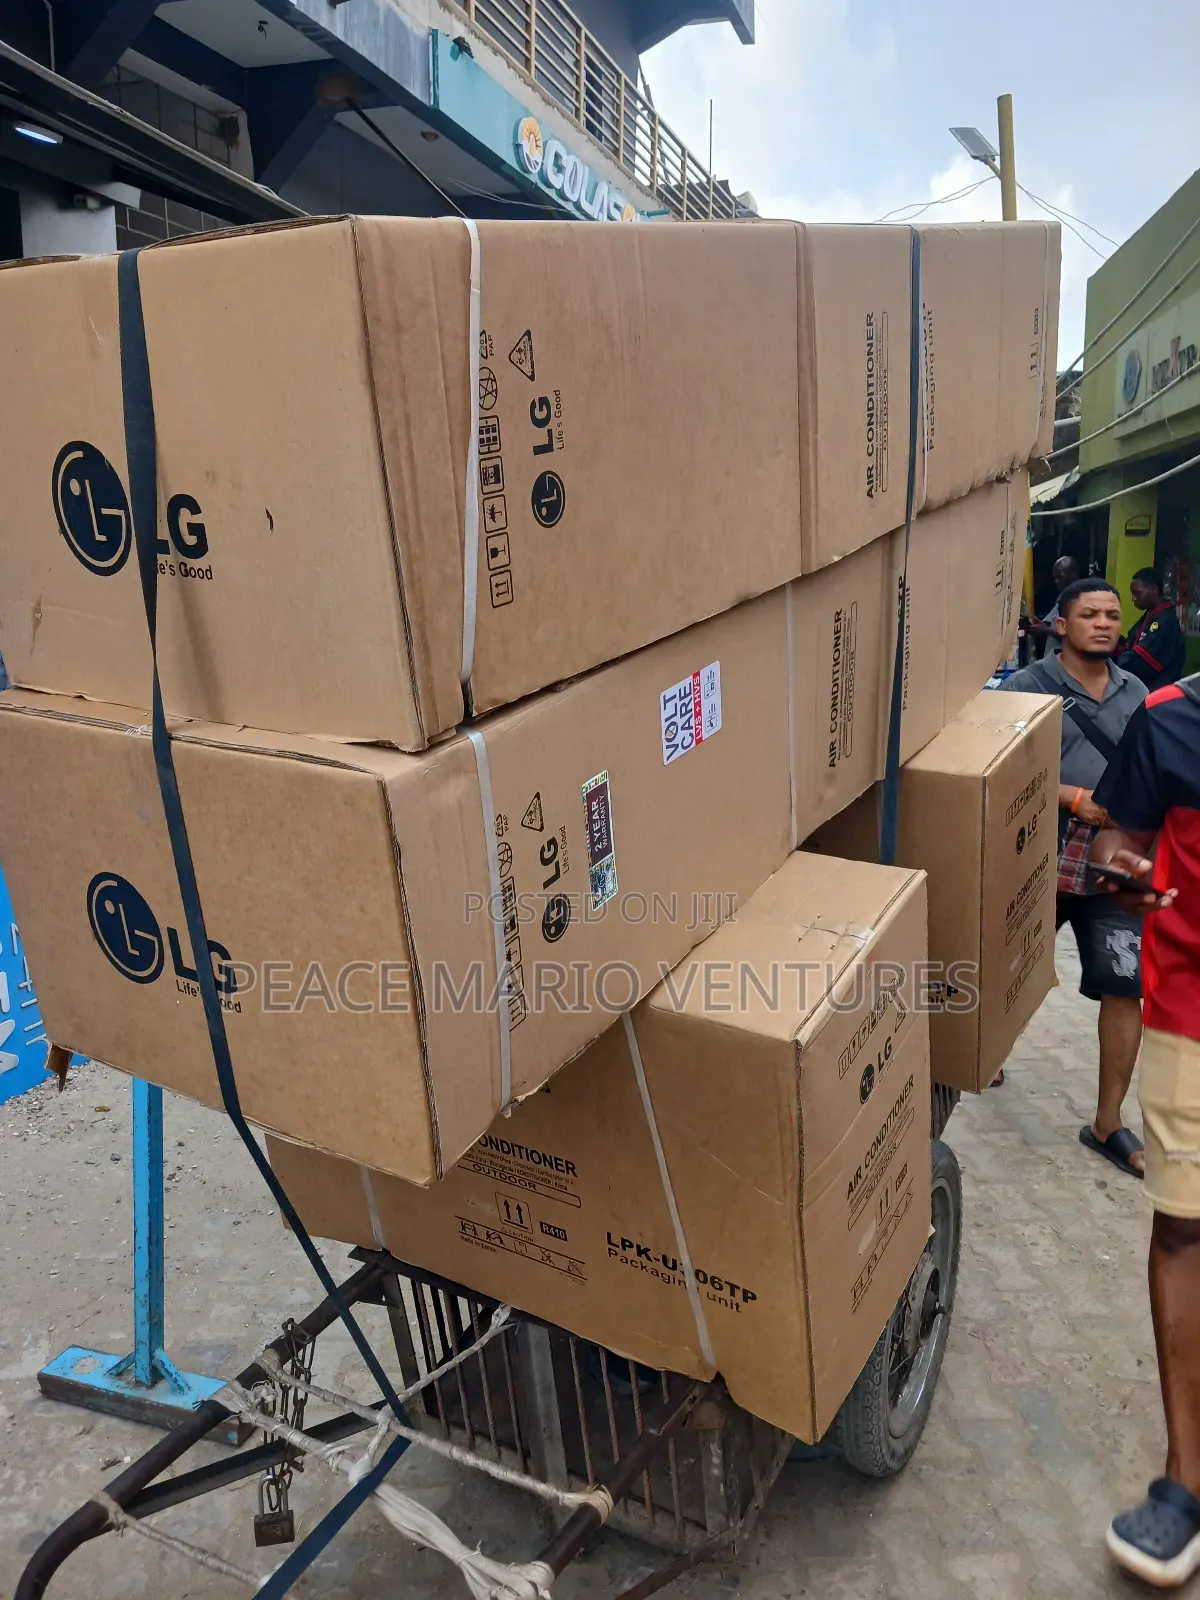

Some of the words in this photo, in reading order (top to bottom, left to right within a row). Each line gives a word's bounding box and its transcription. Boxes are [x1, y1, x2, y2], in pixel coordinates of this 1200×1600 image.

[541, 138, 641, 221] COLAS
[487, 334, 495, 357] PAP
[553, 389, 563, 419] Good
[866, 311, 875, 458] CONDITIONER
[928, 353, 936, 451] Packaging
[530, 396, 554, 456] LG
[556, 421, 565, 451] Life's
[866, 465, 875, 499] AIR
[156, 494, 209, 560] G
[178, 562, 214, 580] Good
[693, 675, 701, 704] HVS
[829, 607, 843, 734] CONDITIONER
[902, 624, 911, 711] Packaging
[663, 693, 680, 762] VOLT
[678, 681, 695, 751] CARE
[694, 715, 702, 740] LVS
[828, 739, 837, 768] AIR
[558, 825, 568, 849] Good
[591, 797, 602, 841] YEAR
[599, 794, 609, 851] WARRANTY
[1027, 814, 1037, 838] LG
[540, 836, 561, 890] LG
[1005, 902, 1016, 922] AIR
[1016, 852, 1049, 906] CONDITIONER
[166, 926, 239, 994] LG
[176, 979, 202, 999] Life'
[877, 1035, 893, 1074] LG
[478, 1134, 579, 1178] ONDITIONER
[847, 1165, 863, 1201] AIR
[864, 1073, 915, 1170] CONDITIONER
[472, 1163, 538, 1191] OUTDOOR
[542, 1223, 566, 1239] R410
[607, 1247, 699, 1295] Packagin
[706, 1290, 742, 1313] unit
